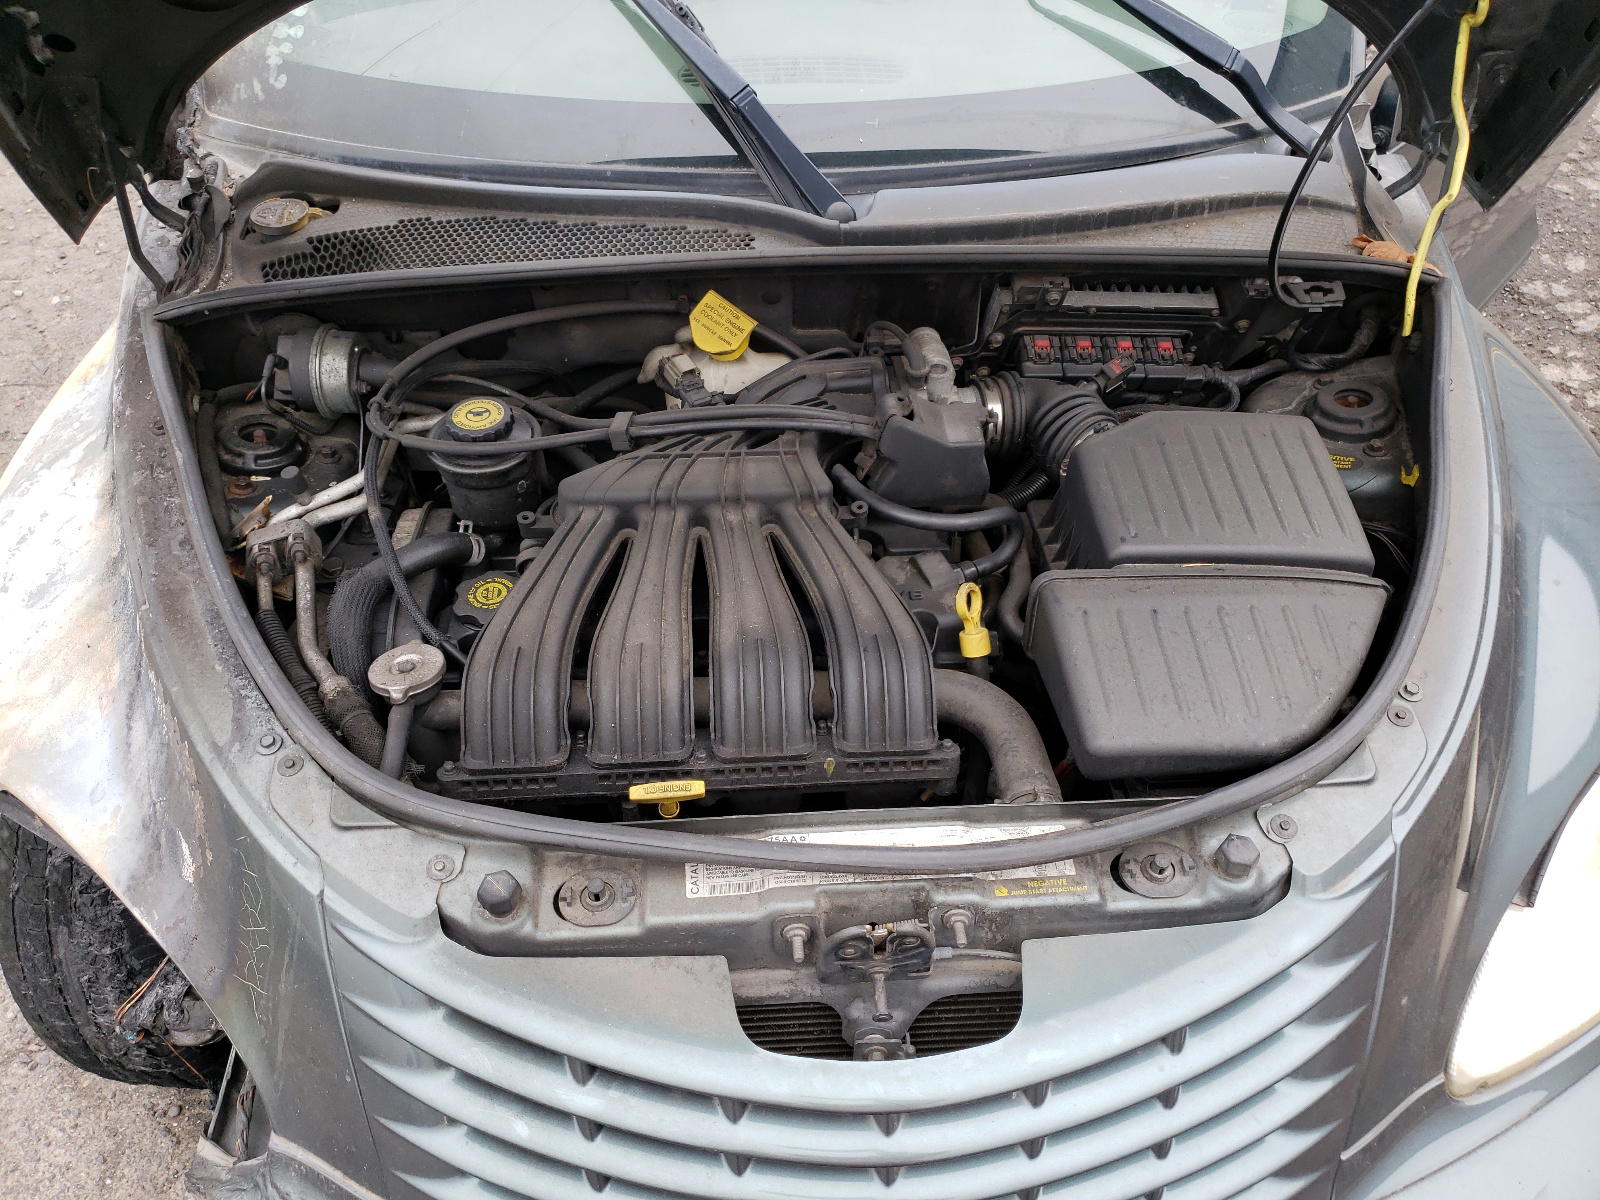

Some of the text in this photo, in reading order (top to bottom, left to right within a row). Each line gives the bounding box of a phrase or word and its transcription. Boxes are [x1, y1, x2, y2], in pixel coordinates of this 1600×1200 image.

[703, 302, 746, 335] SPECIAL ENGINE
[718, 302, 741, 321] CAUTION
[700, 309, 739, 338] COOLANT ONLY
[659, 783, 692, 793] ENGINE
[1027, 878, 1068, 888] NEGATIVE
